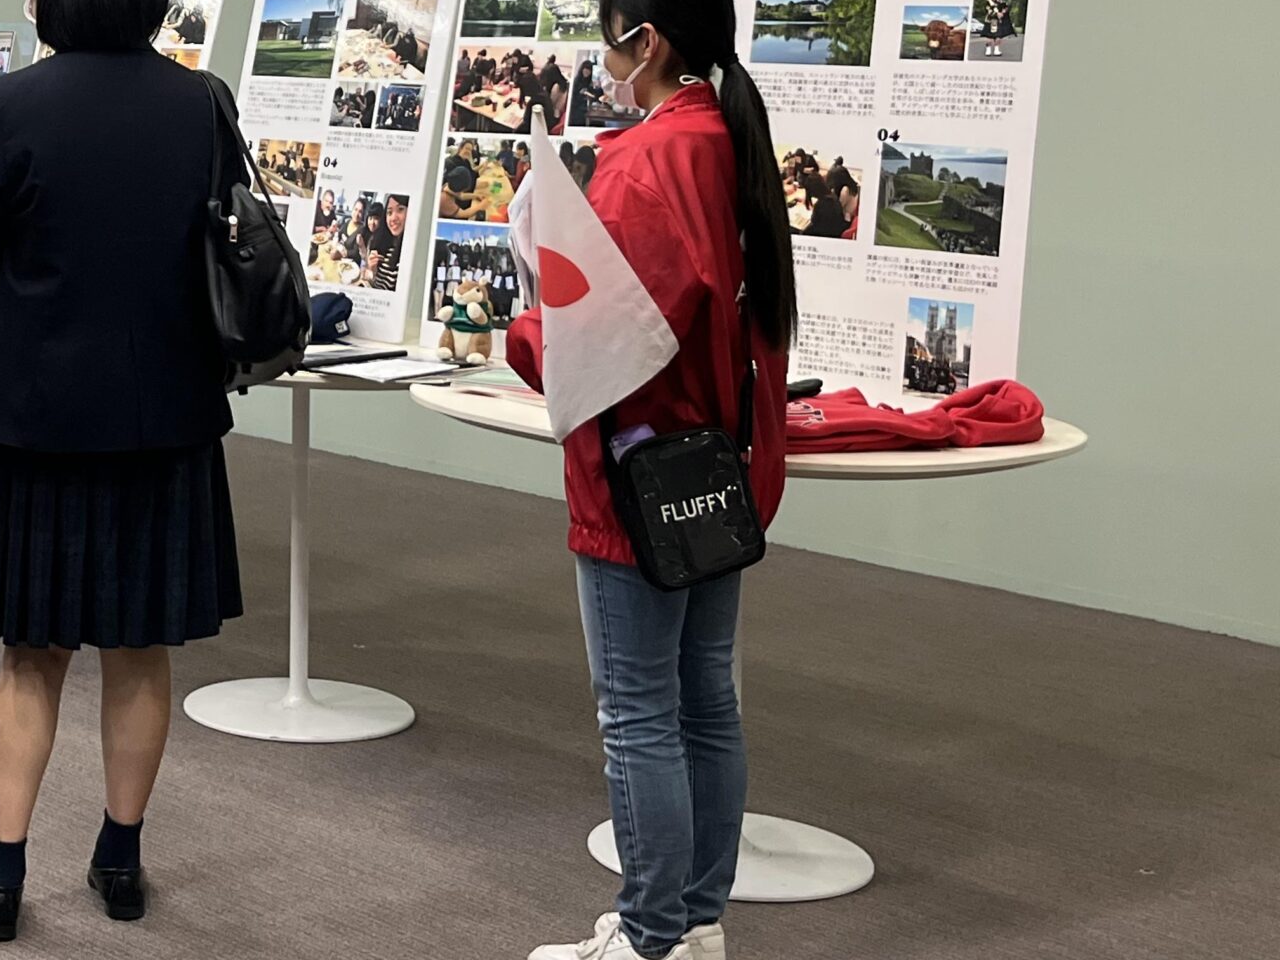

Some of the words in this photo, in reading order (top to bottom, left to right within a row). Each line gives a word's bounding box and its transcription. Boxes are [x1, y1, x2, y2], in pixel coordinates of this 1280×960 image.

[877, 128, 901, 142] 04
[323, 156, 338, 168] 04
[660, 490, 728, 524] FLUFFY
